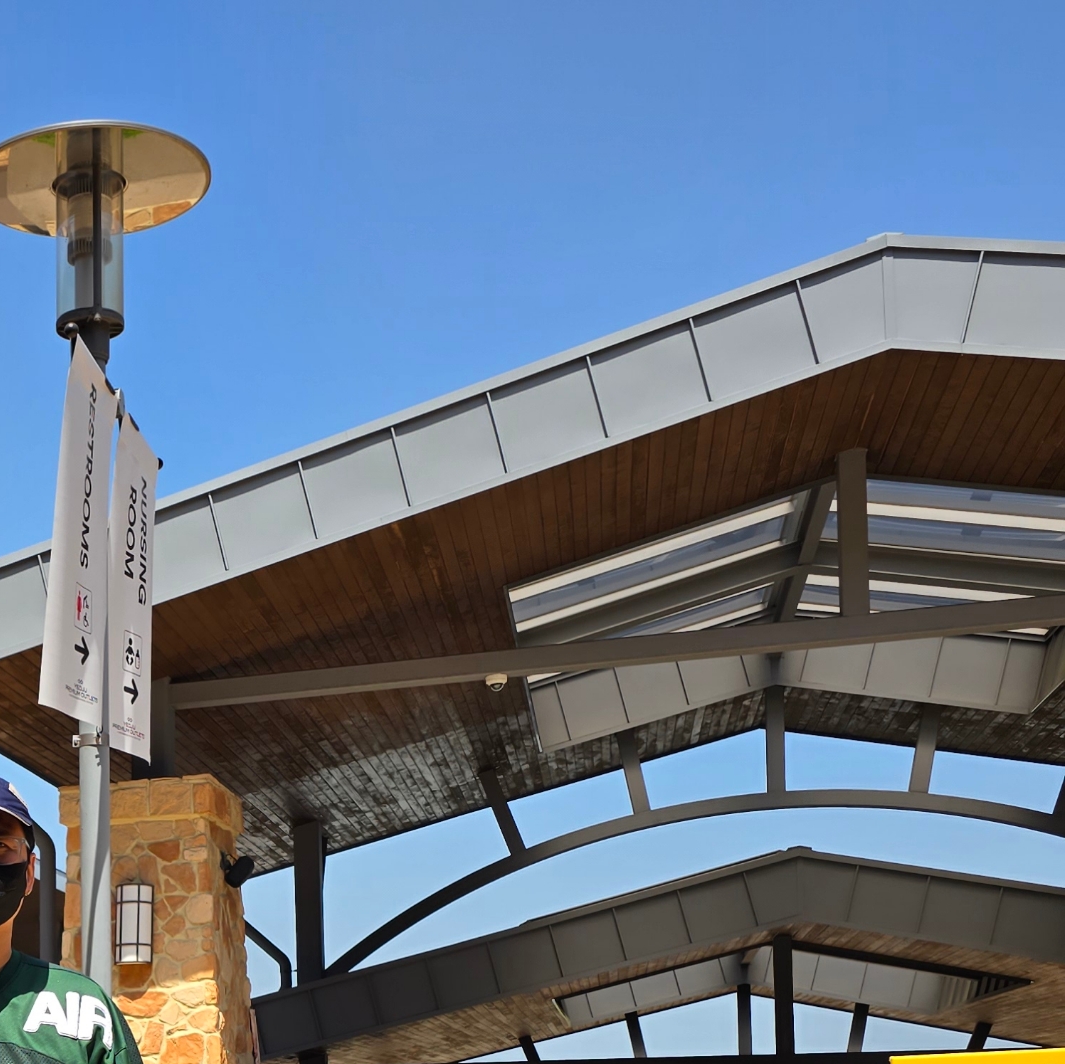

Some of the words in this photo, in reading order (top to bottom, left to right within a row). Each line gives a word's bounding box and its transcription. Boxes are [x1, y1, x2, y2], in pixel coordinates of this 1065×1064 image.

[79, 382, 97, 570] RESTROOMS
[124, 485, 137, 580] ROOM
[138, 475, 148, 606] NURSING
[23, 990, 114, 1050] AIR
